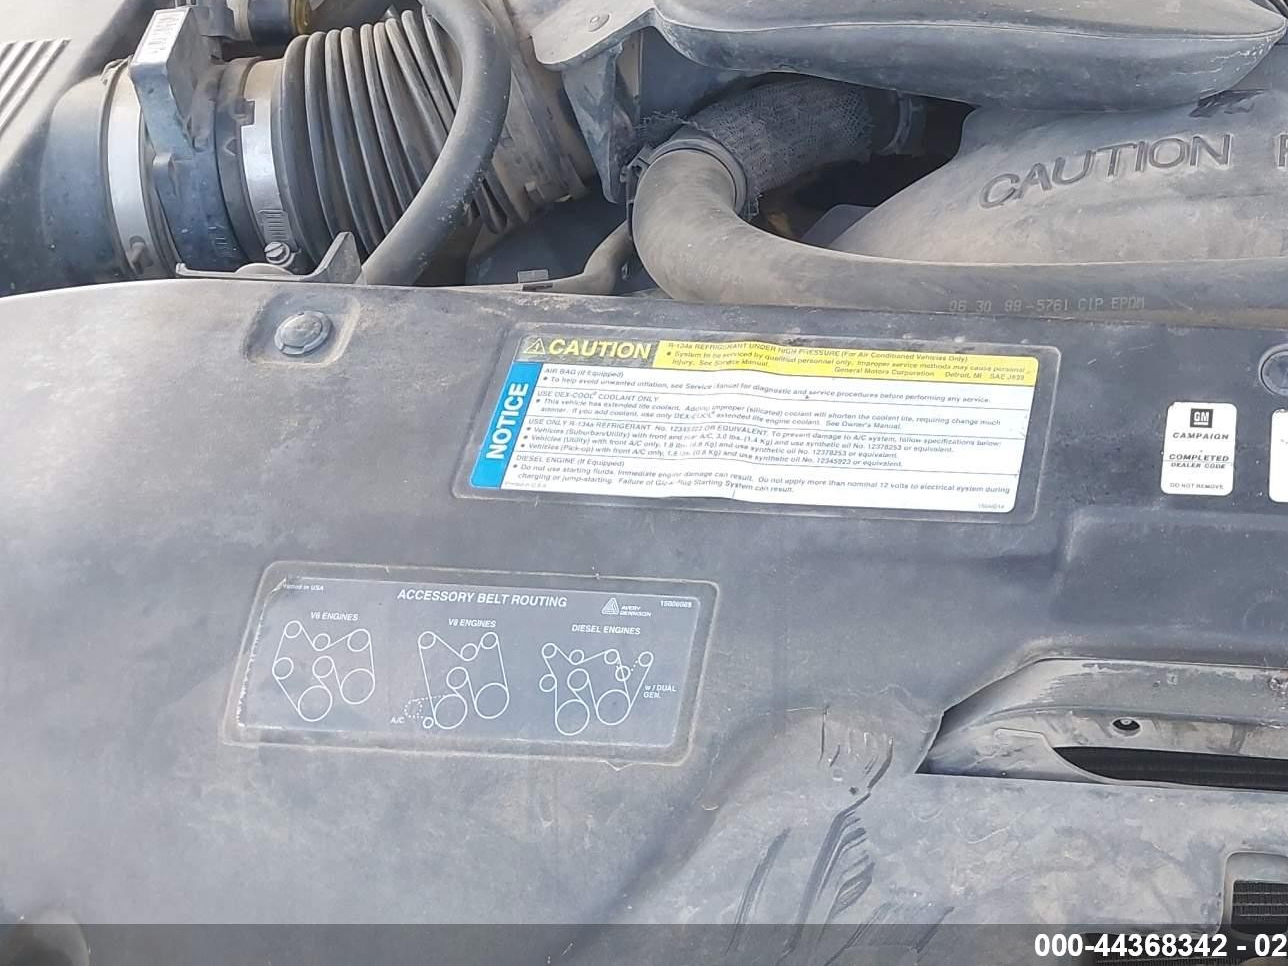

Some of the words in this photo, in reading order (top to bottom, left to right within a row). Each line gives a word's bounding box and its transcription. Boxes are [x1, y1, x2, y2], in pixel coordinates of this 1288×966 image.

[979, 134, 1232, 209] CAUTION
[549, 338, 651, 359] CAUTION
[486, 383, 529, 460] NOTICE
[1172, 432, 1230, 440] CAMPAIGN
[1169, 453, 1230, 462] COMPLETED
[397, 589, 475, 602] ACCESSORY
[477, 593, 509, 605] BELT
[512, 594, 568, 607] ROUTING
[322, 612, 358, 621] ENGINES
[460, 619, 496, 628] ENGINES
[572, 624, 602, 633] DIESEL
[604, 626, 640, 635] ENGINES
[656, 684, 676, 692] DUAL
